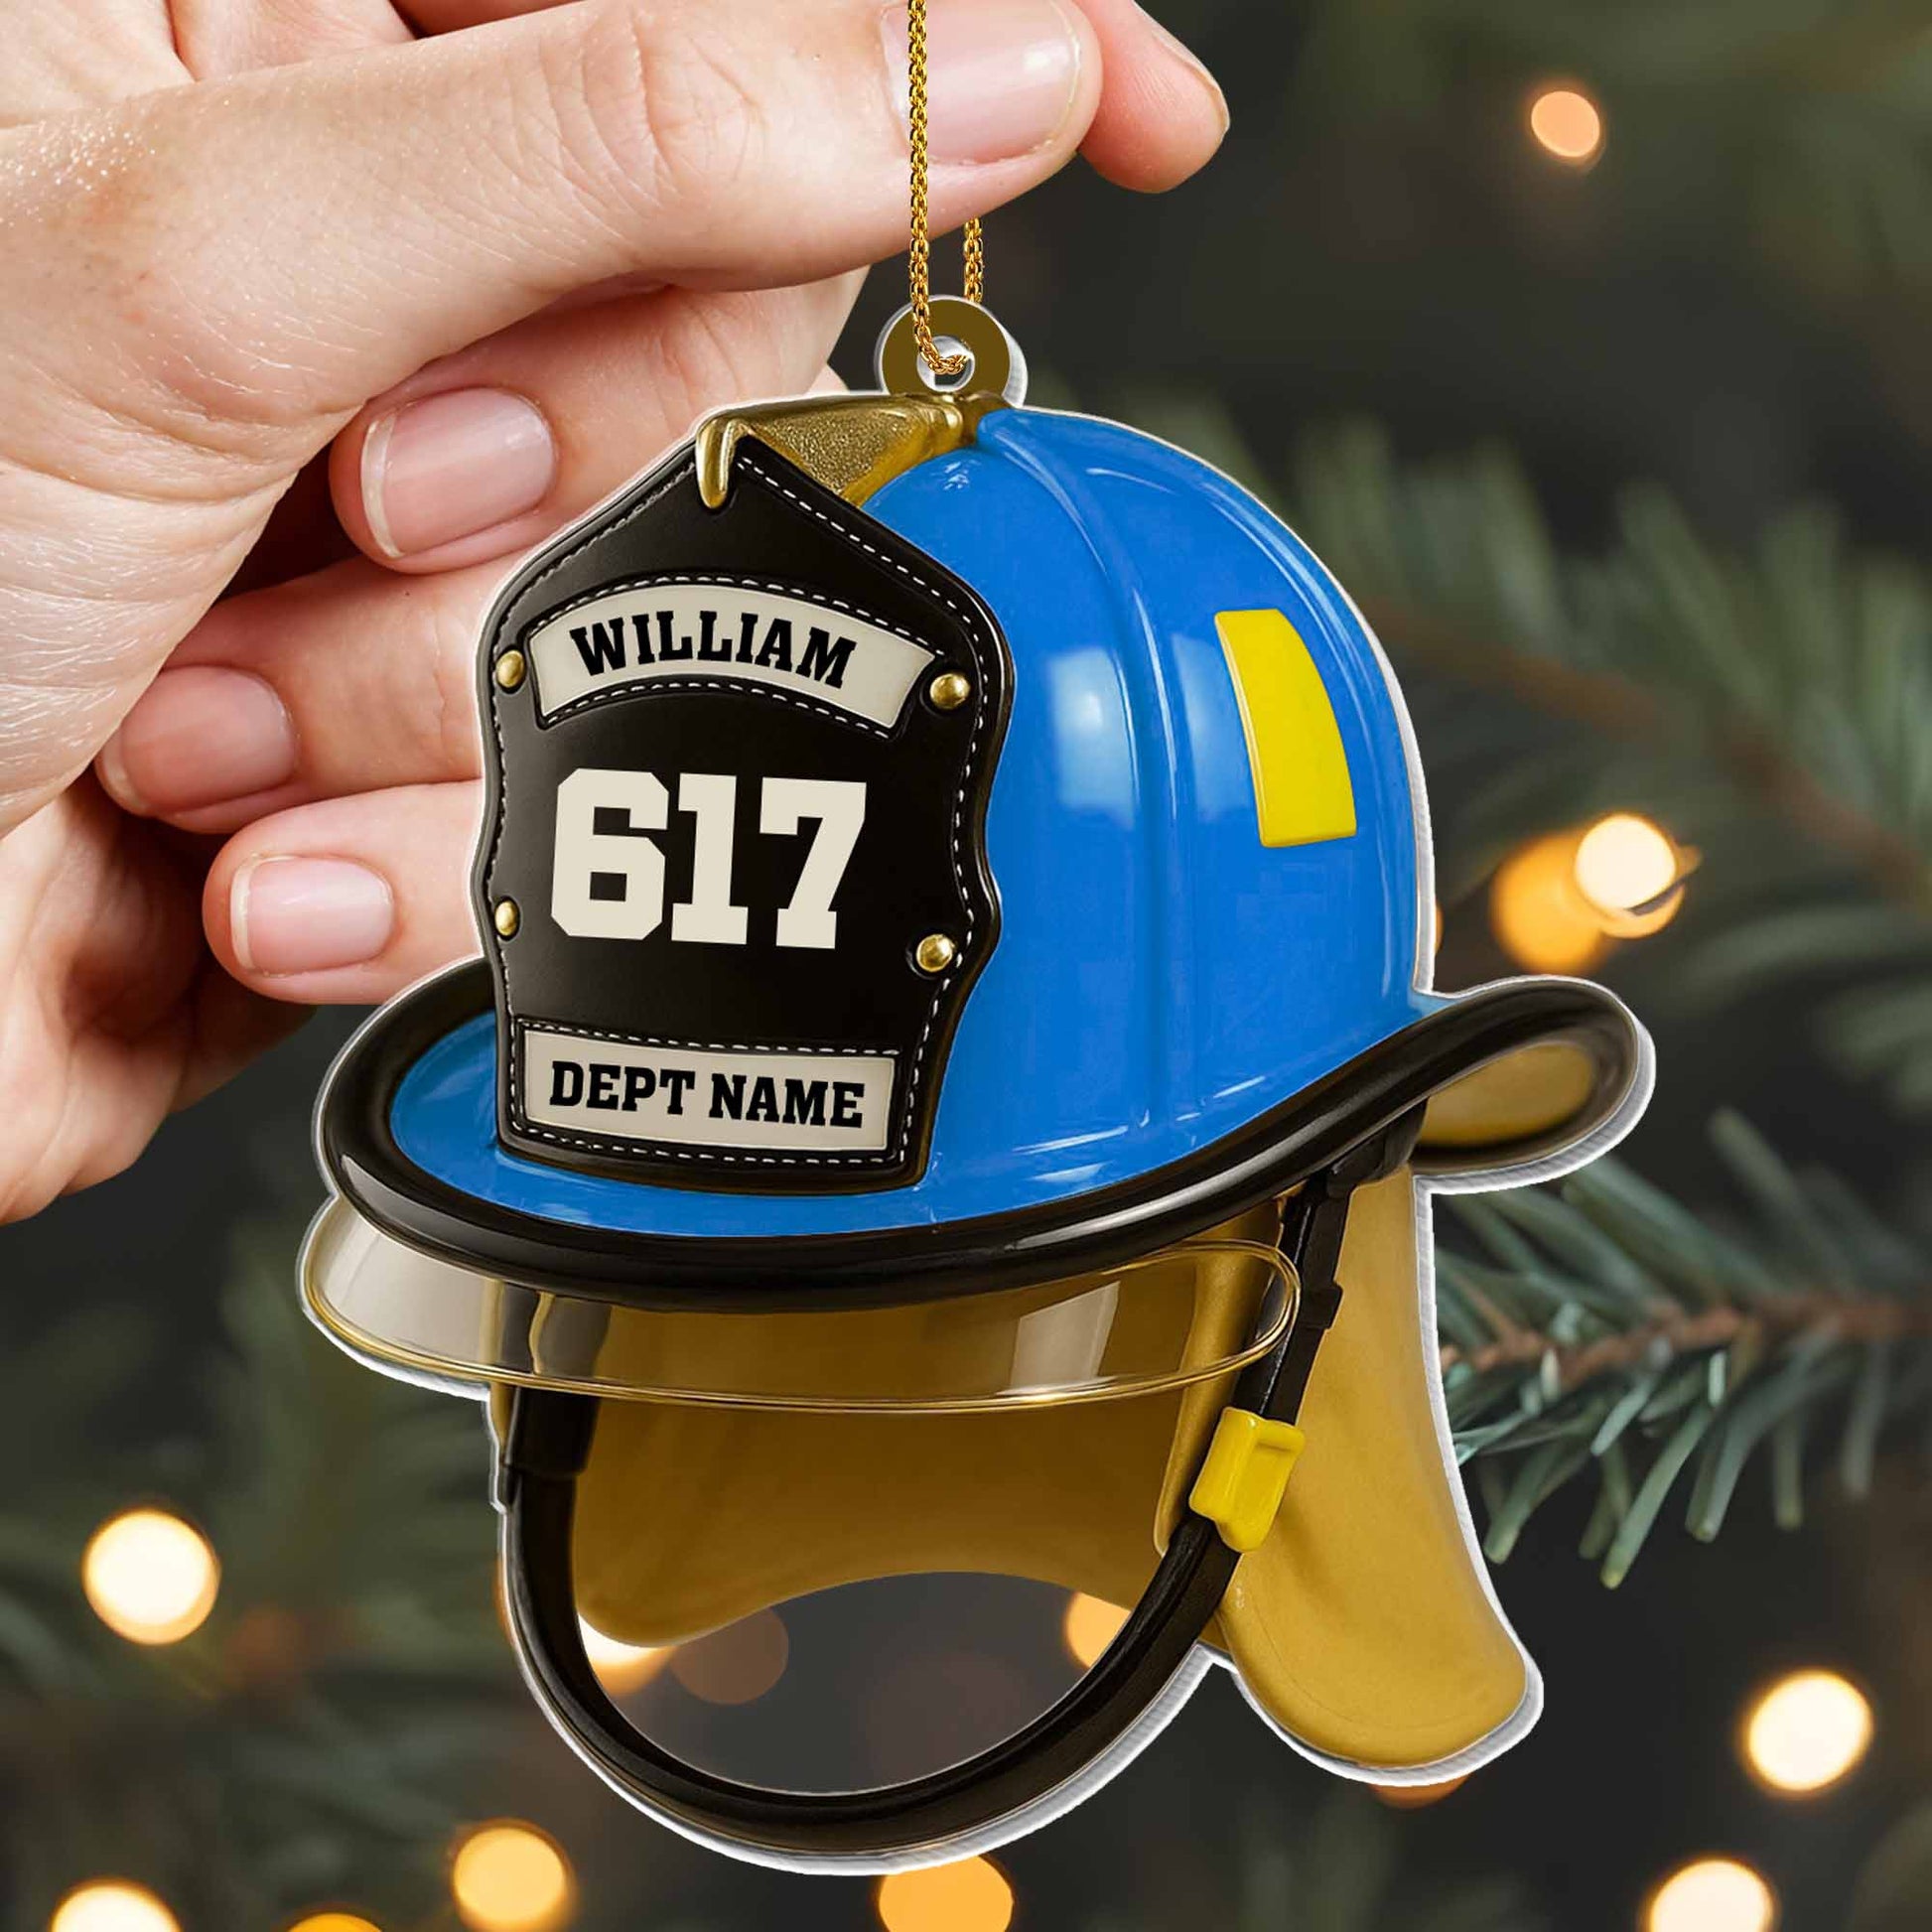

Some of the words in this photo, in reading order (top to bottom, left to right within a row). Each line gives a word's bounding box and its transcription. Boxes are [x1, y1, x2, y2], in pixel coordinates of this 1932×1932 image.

[569, 610, 858, 690] WILLIAM
[551, 767, 868, 949] 617
[549, 1060, 696, 1116] DEPT
[708, 1072, 866, 1129] NAME
